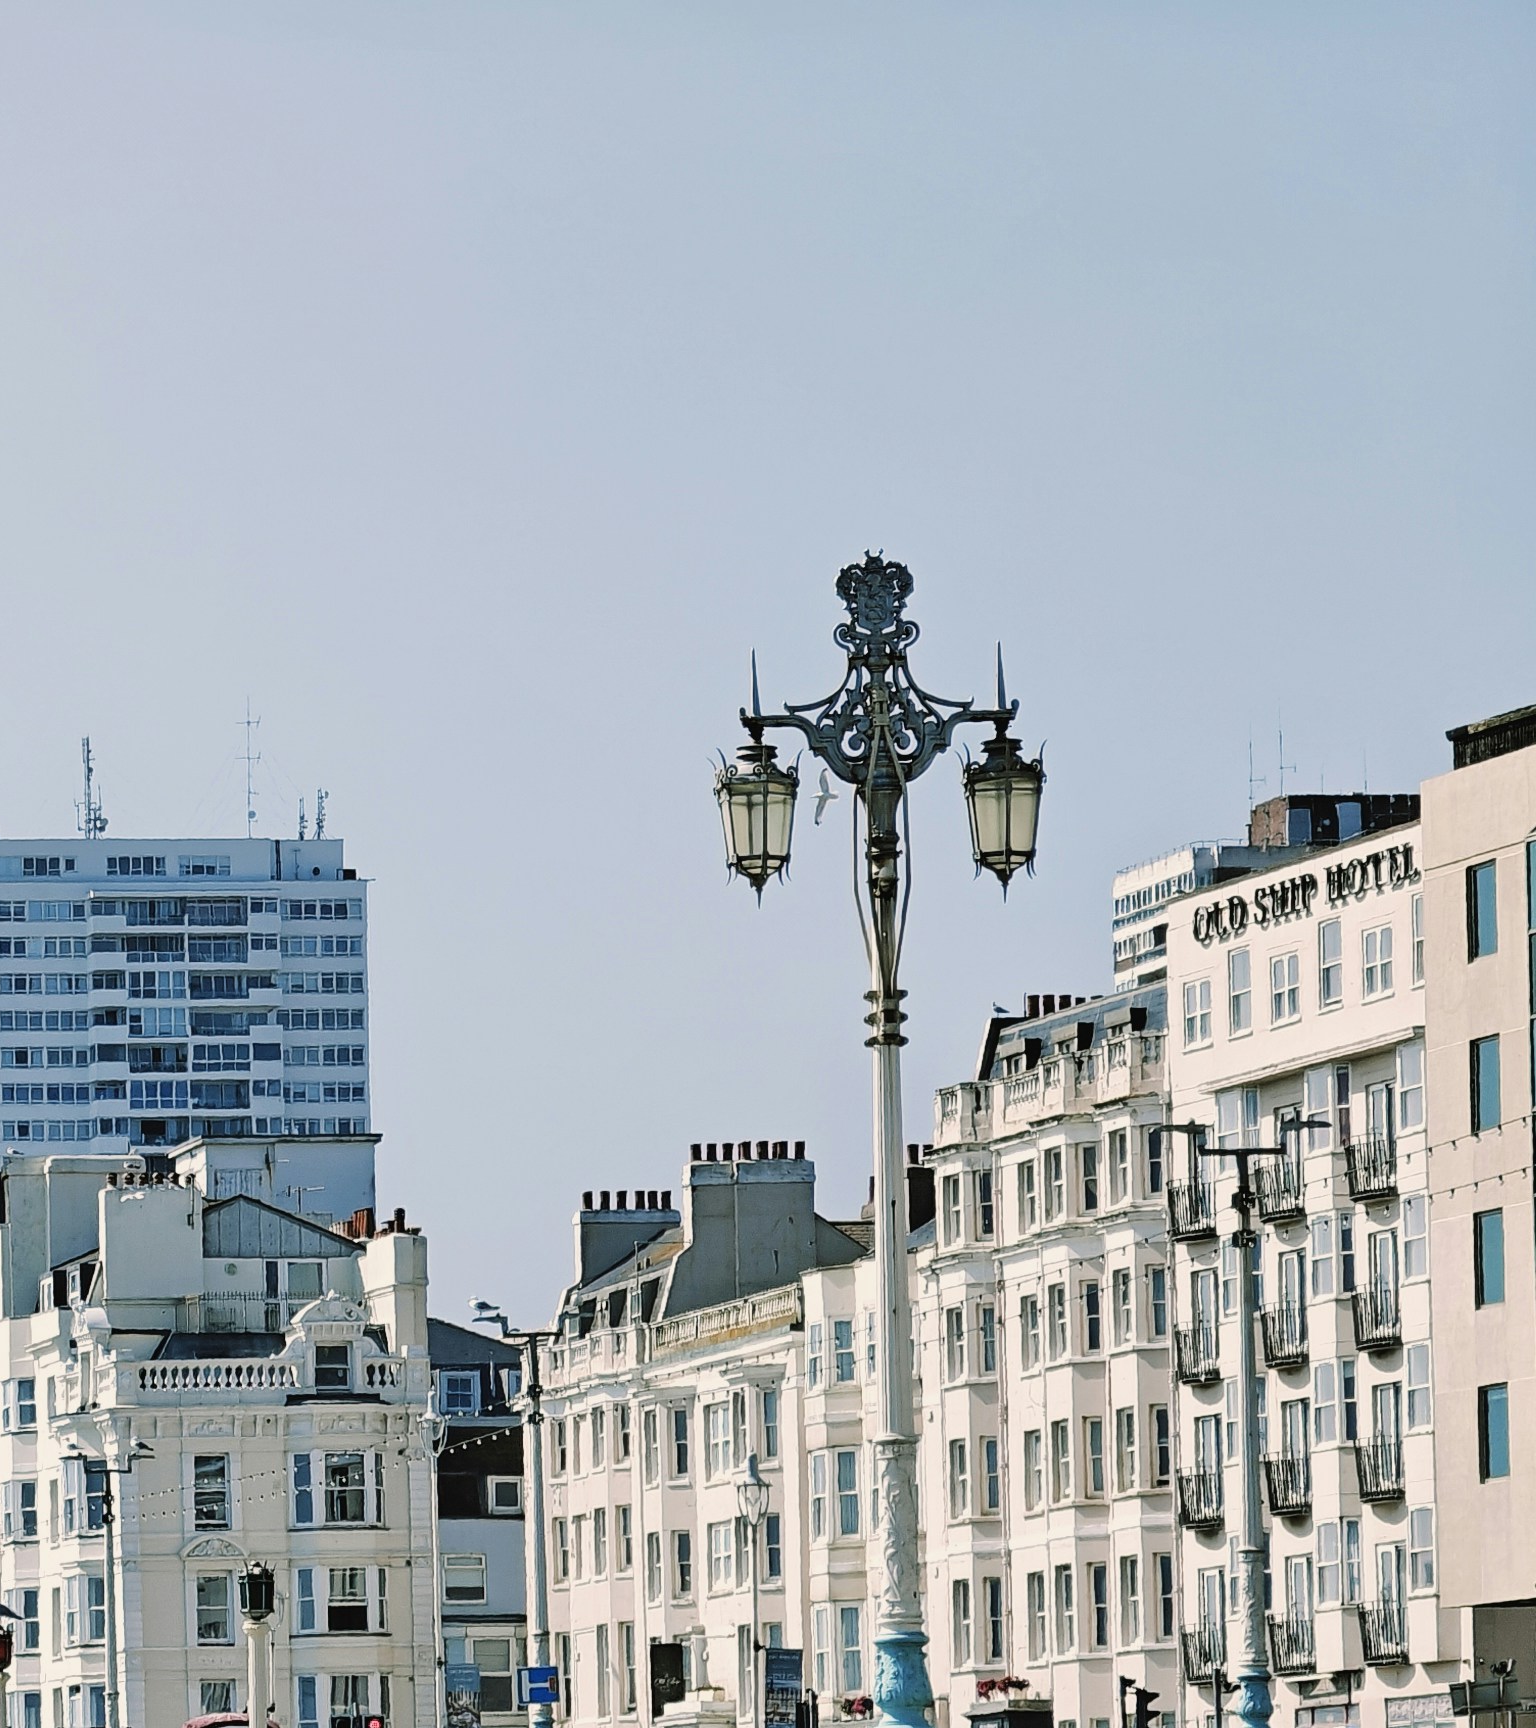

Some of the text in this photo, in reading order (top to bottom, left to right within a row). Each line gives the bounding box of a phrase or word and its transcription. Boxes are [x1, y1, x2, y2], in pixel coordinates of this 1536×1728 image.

[1193, 842, 1421, 946] OLD SHIP HOTEL
